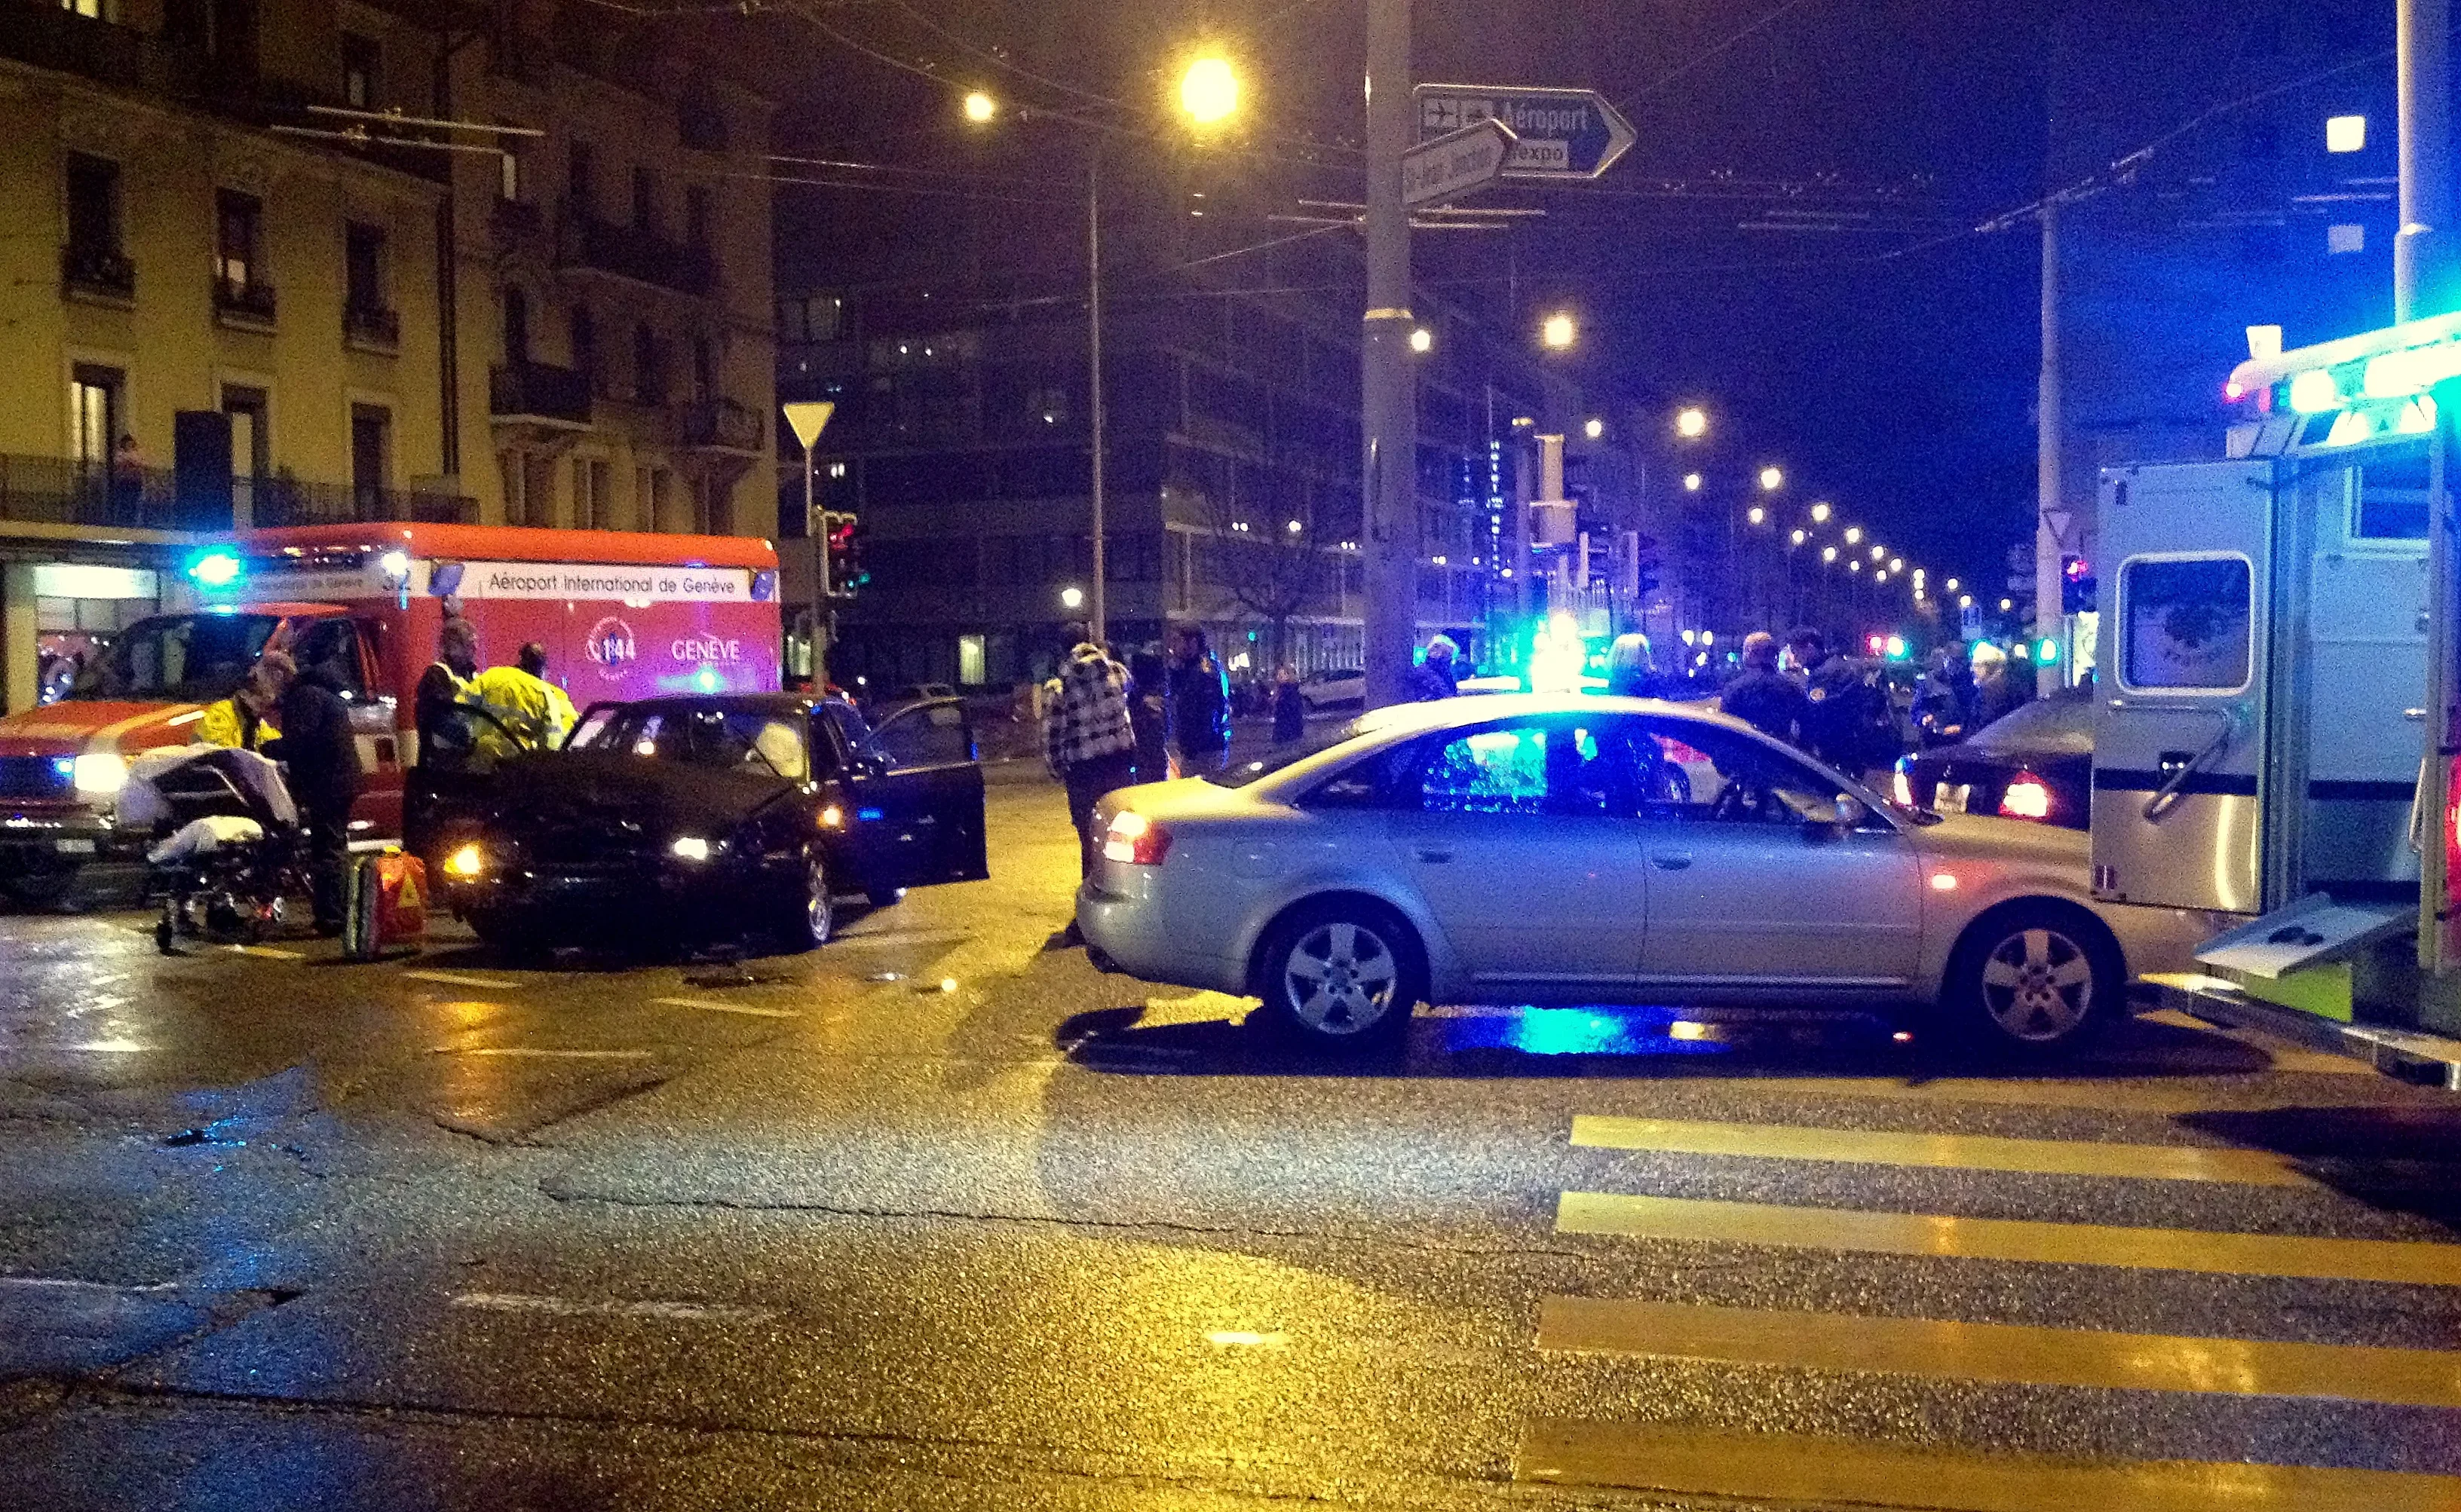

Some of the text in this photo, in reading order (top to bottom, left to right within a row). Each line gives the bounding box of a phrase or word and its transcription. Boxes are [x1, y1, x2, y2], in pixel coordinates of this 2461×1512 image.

[1502, 101, 1589, 137] Aéroport
[490, 571, 735, 594] Aéroport International de Genève
